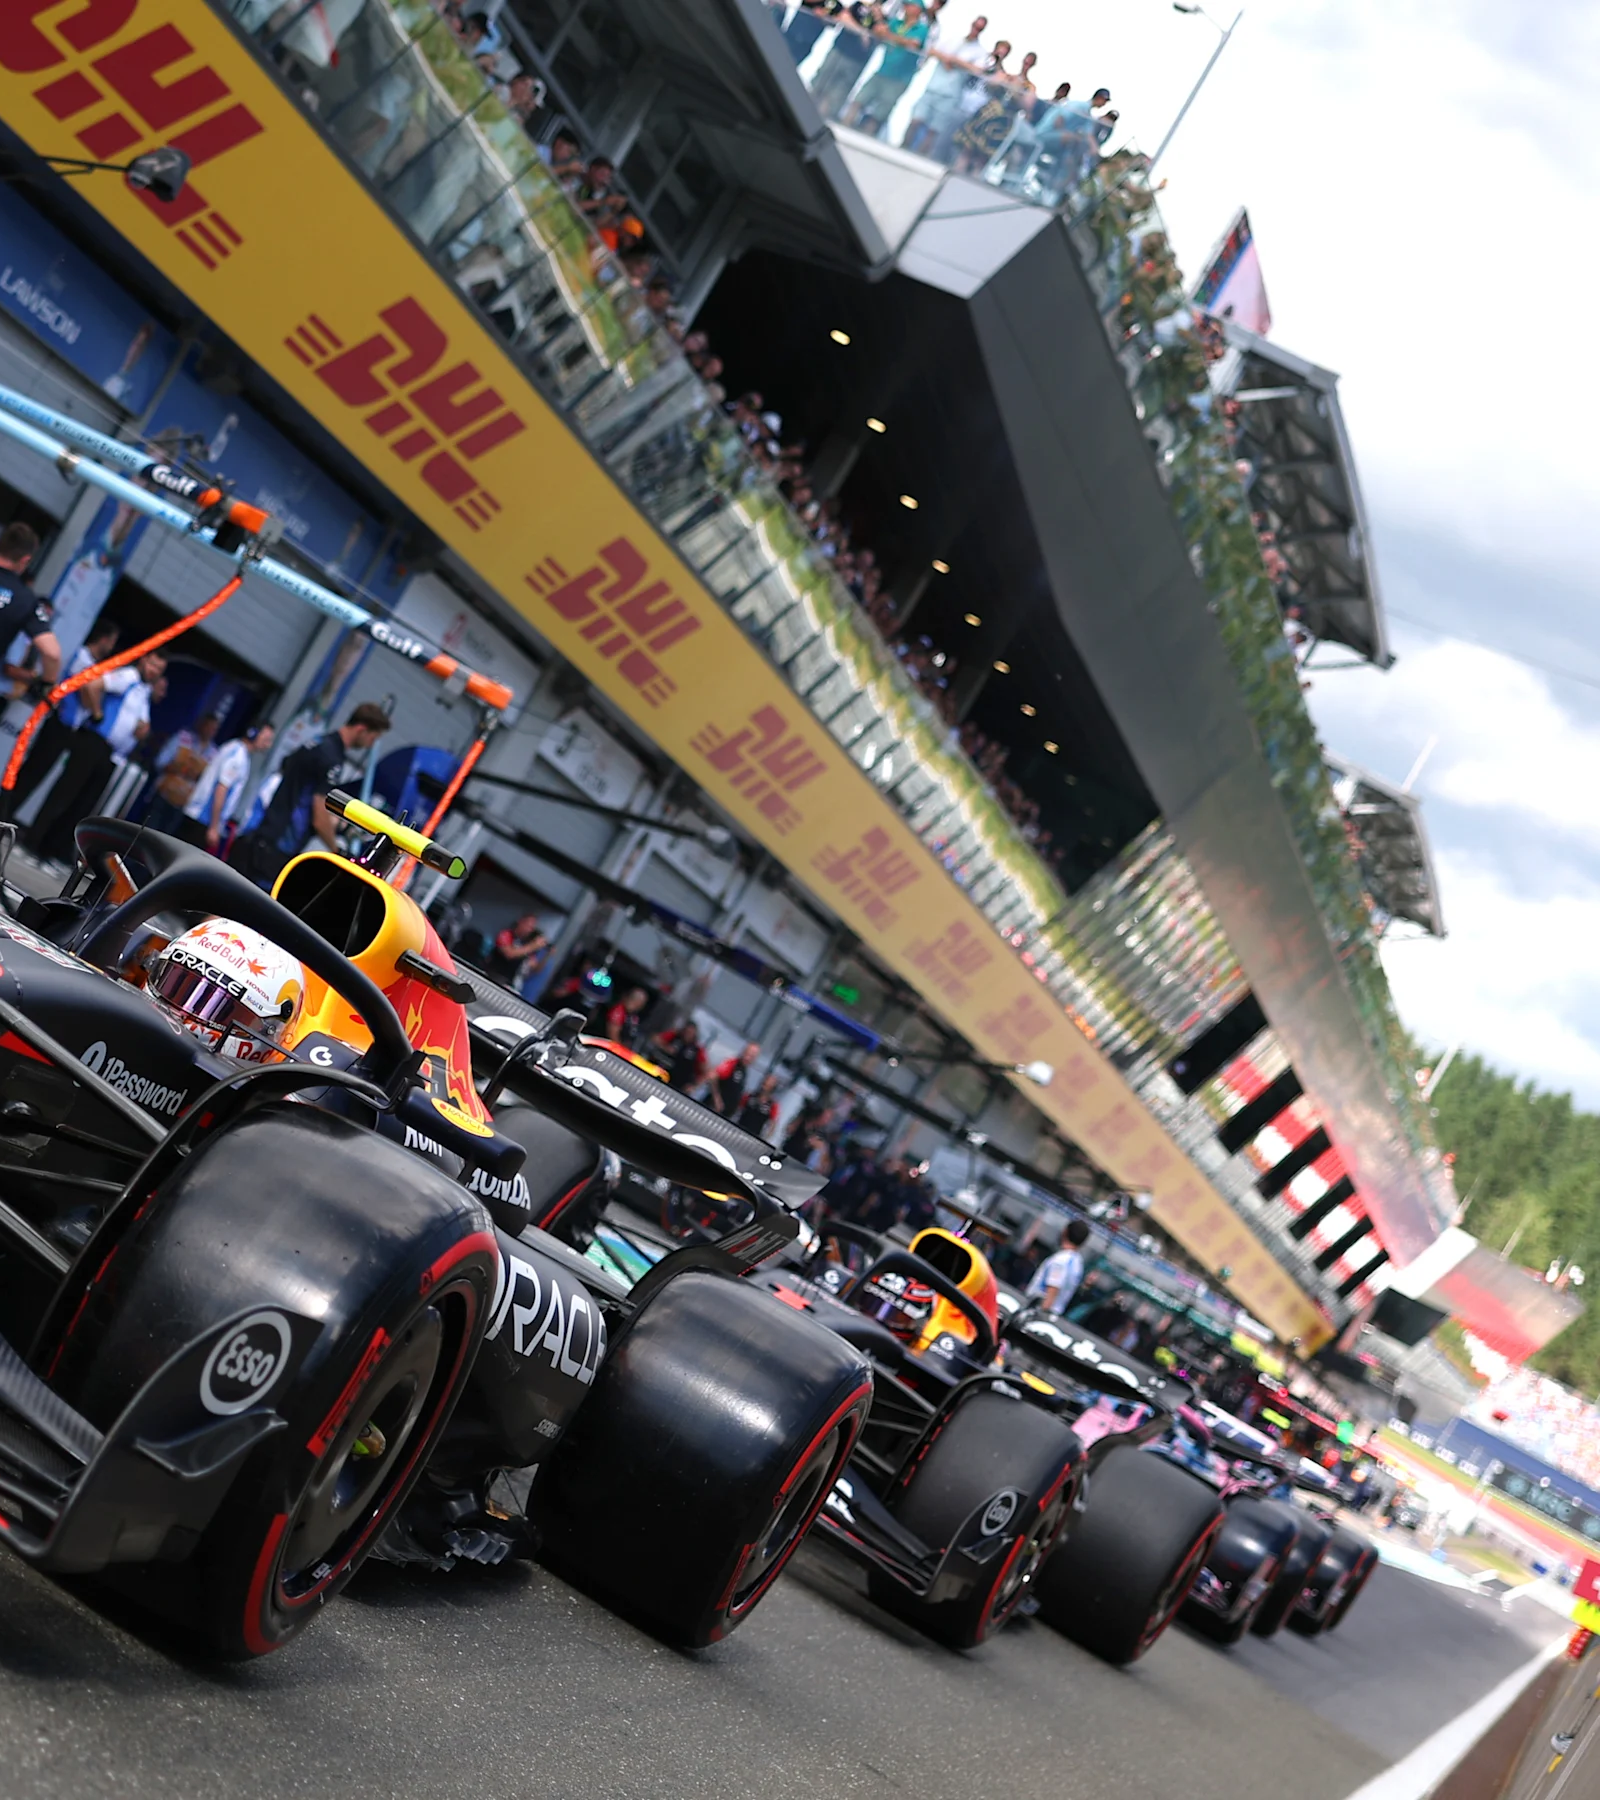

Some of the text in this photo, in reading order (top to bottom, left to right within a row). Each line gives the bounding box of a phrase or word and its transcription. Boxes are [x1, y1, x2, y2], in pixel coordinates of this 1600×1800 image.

[314, 296, 527, 506] DHL
[151, 463, 198, 496] Gulf
[546, 536, 702, 690] DHL
[370, 620, 424, 659] Gulf
[705, 704, 828, 823] DHL
[171, 950, 243, 997] ORACLE
[198, 936, 246, 969] Red Bull
[245, 979, 270, 1002] HONDA
[101, 1056, 188, 1116] 1Password
[448, 1107, 486, 1133] RAUCH
